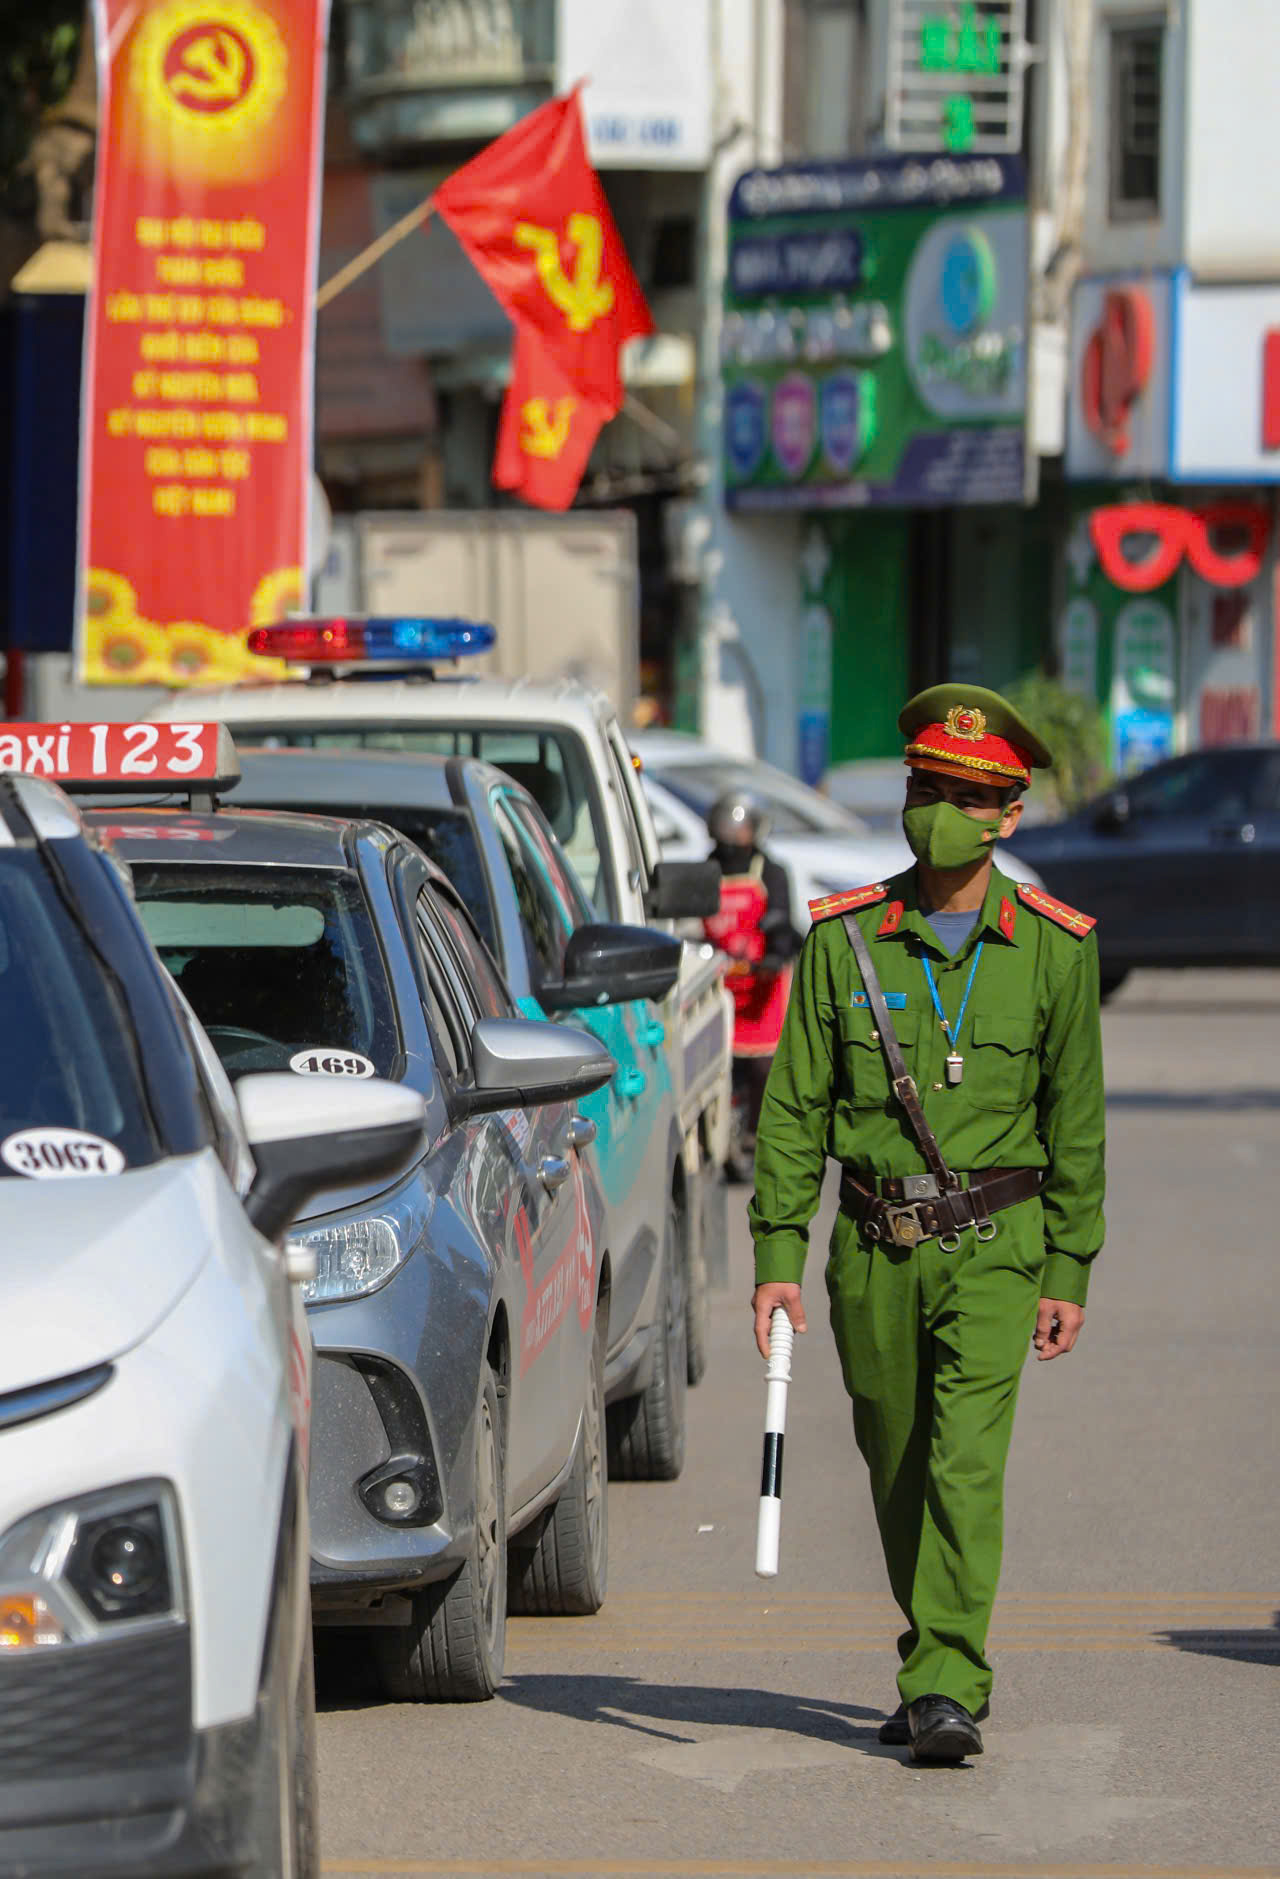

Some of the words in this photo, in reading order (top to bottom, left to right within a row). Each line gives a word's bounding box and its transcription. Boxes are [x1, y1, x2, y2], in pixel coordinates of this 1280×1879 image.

[89, 722, 207, 775] 123
[297, 1056, 367, 1077] 469
[14, 1140, 109, 1175] 3067
